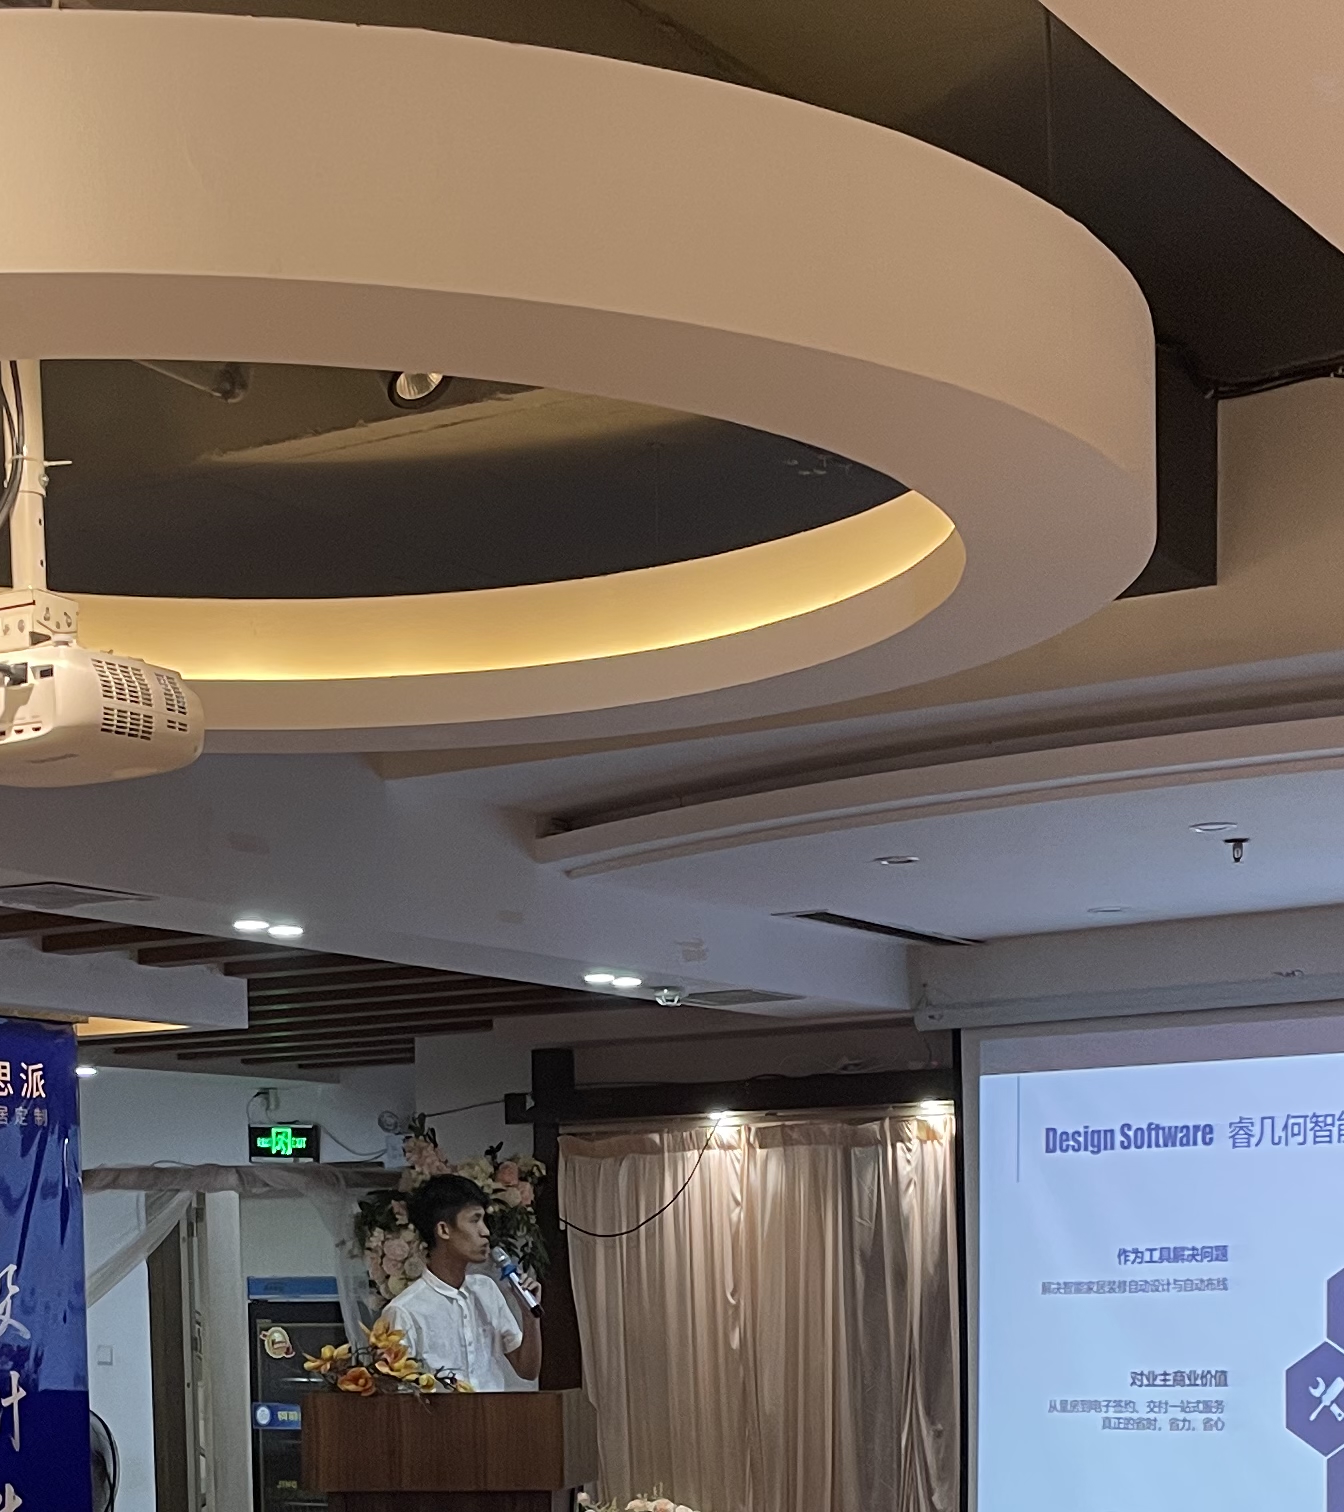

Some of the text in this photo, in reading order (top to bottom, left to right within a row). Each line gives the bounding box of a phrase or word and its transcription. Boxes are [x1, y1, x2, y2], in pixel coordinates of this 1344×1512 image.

[1045, 1126, 1115, 1154] Design
[1120, 1122, 1215, 1150] Software
[1117, 1245, 1229, 1265] 作为工具解决问题
[1130, 1370, 1229, 1388] 对业主商业价值
